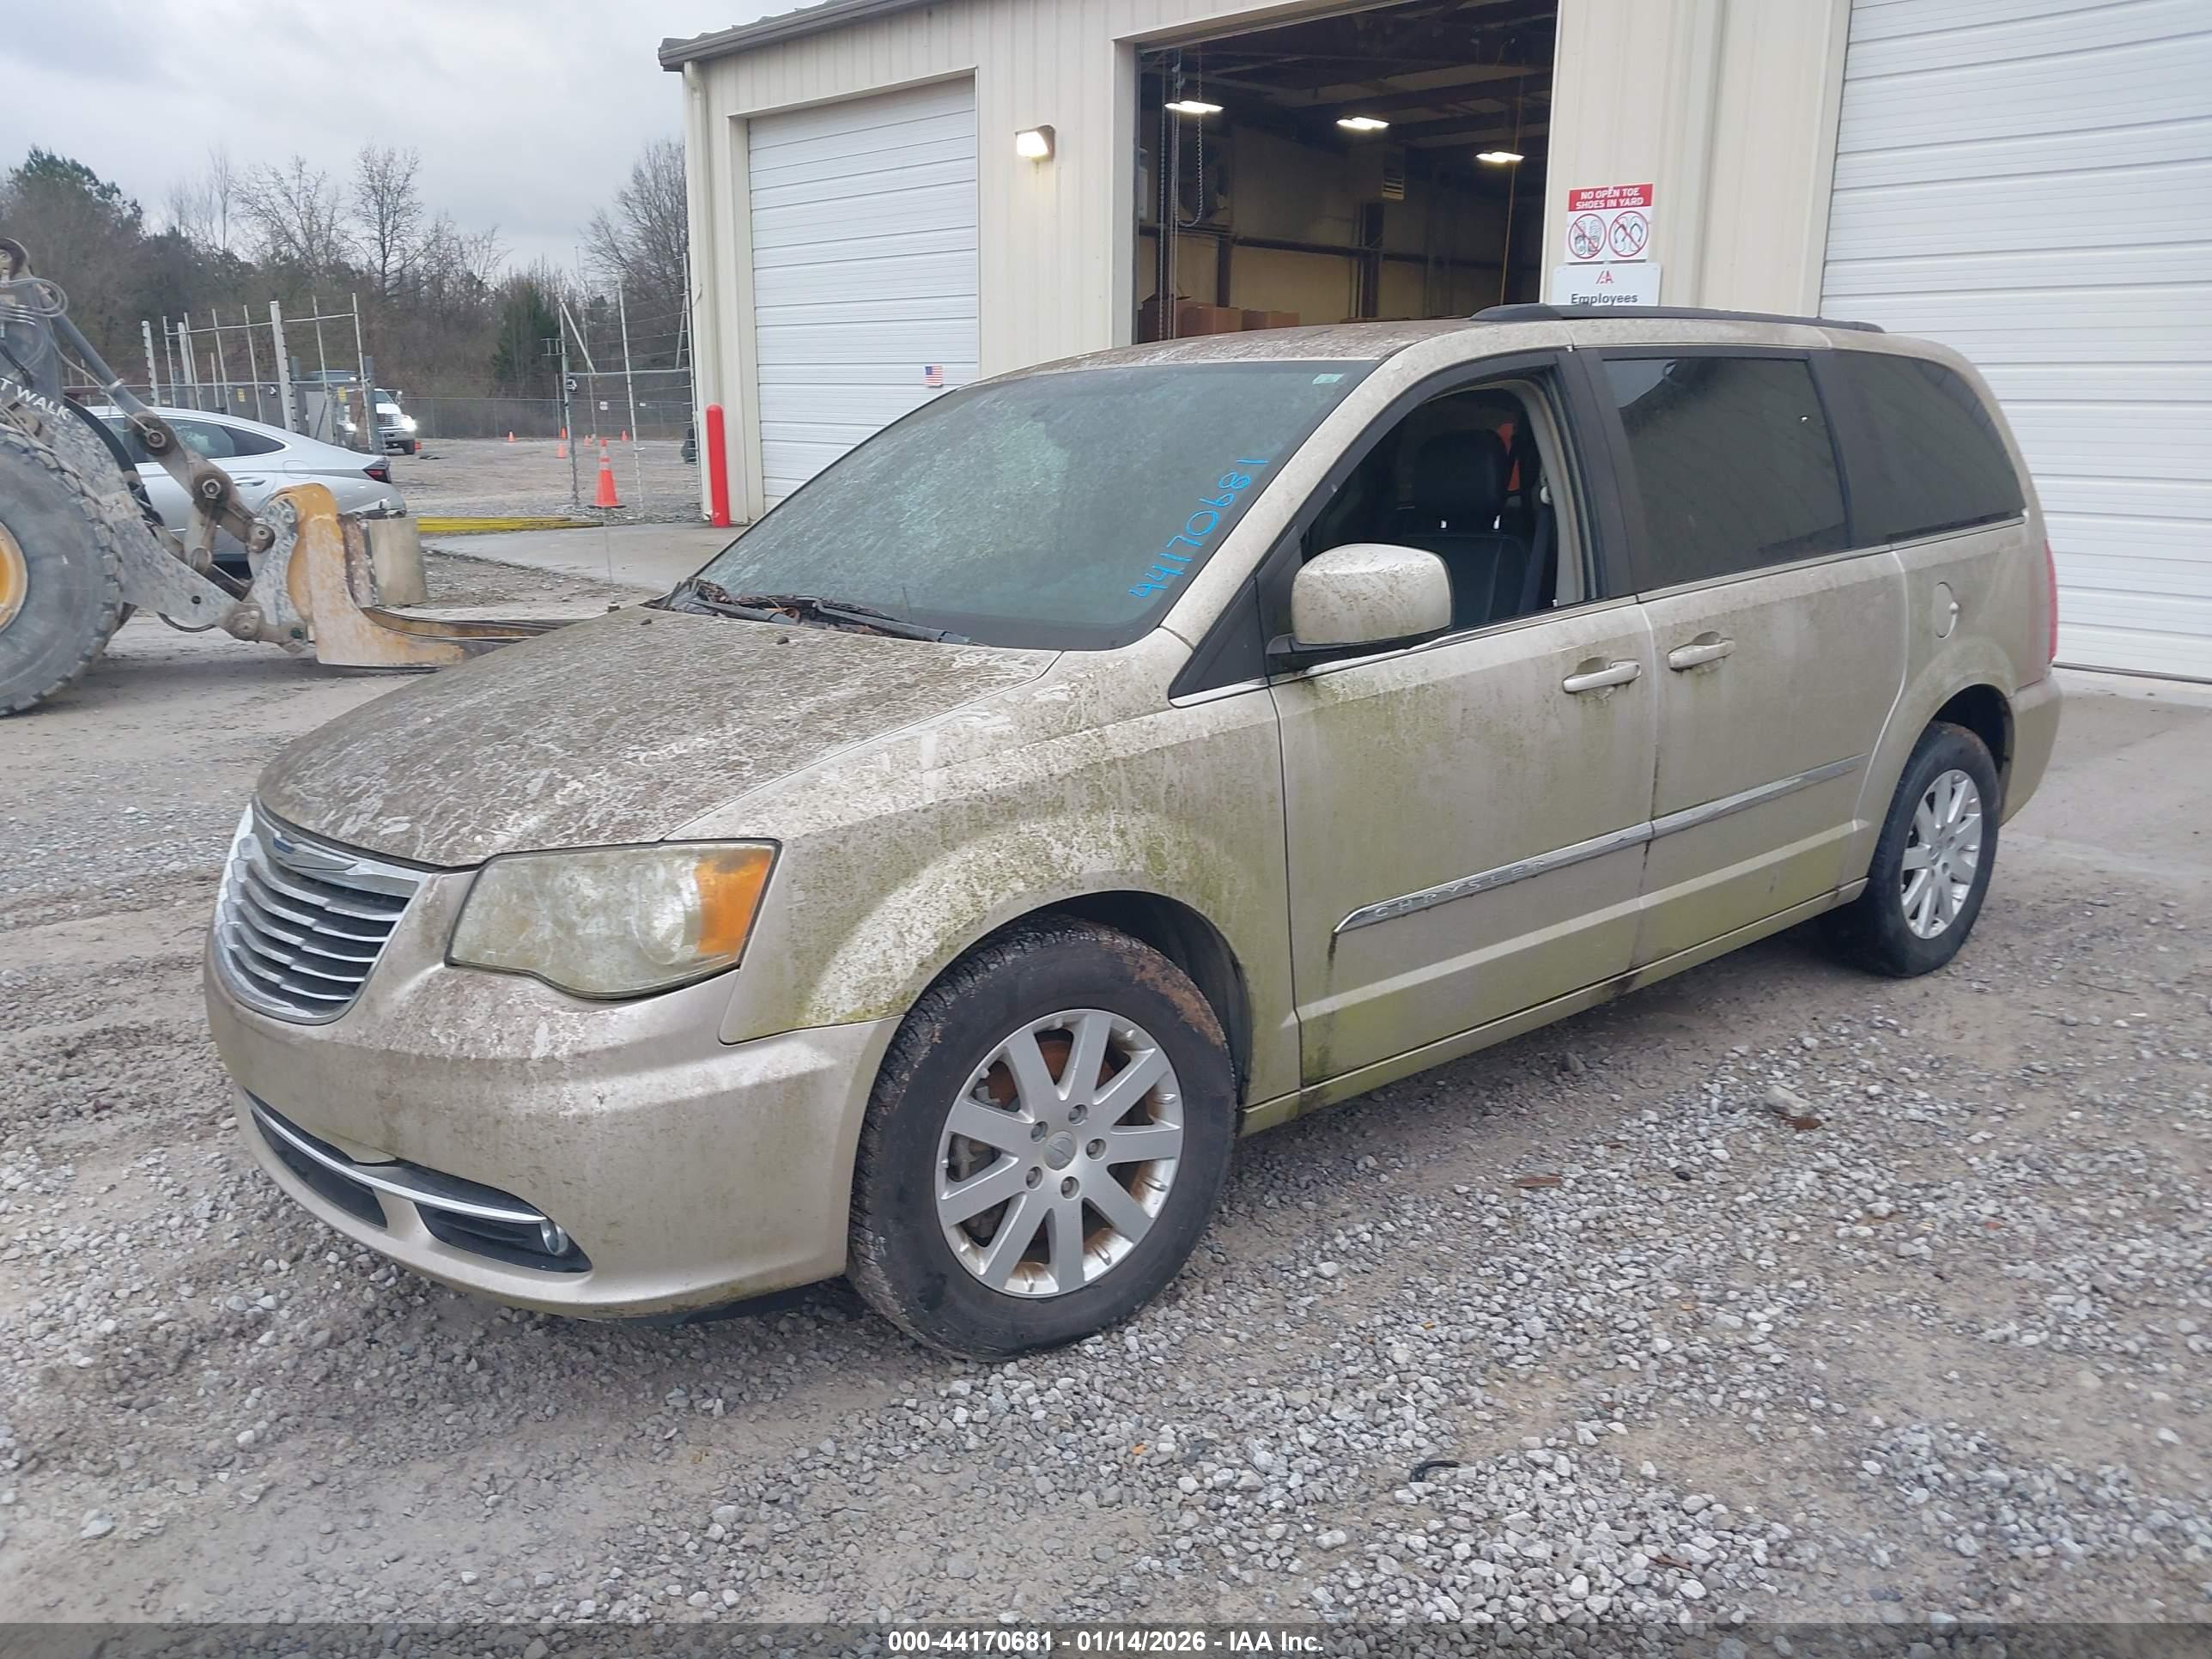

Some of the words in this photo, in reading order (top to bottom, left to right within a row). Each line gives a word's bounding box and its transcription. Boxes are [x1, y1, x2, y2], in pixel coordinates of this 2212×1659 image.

[1580, 191, 1595, 200] NO
[1595, 188, 1620, 199] OPEN
[1621, 187, 1641, 197] TOE
[1576, 199, 1606, 210] SHOES
[1607, 198, 1618, 208] IN
[1619, 197, 1644, 207] YARD
[1571, 293, 1638, 306] Employees
[17, 385, 70, 420] WALK
[1128, 459, 1269, 598] 44170681
